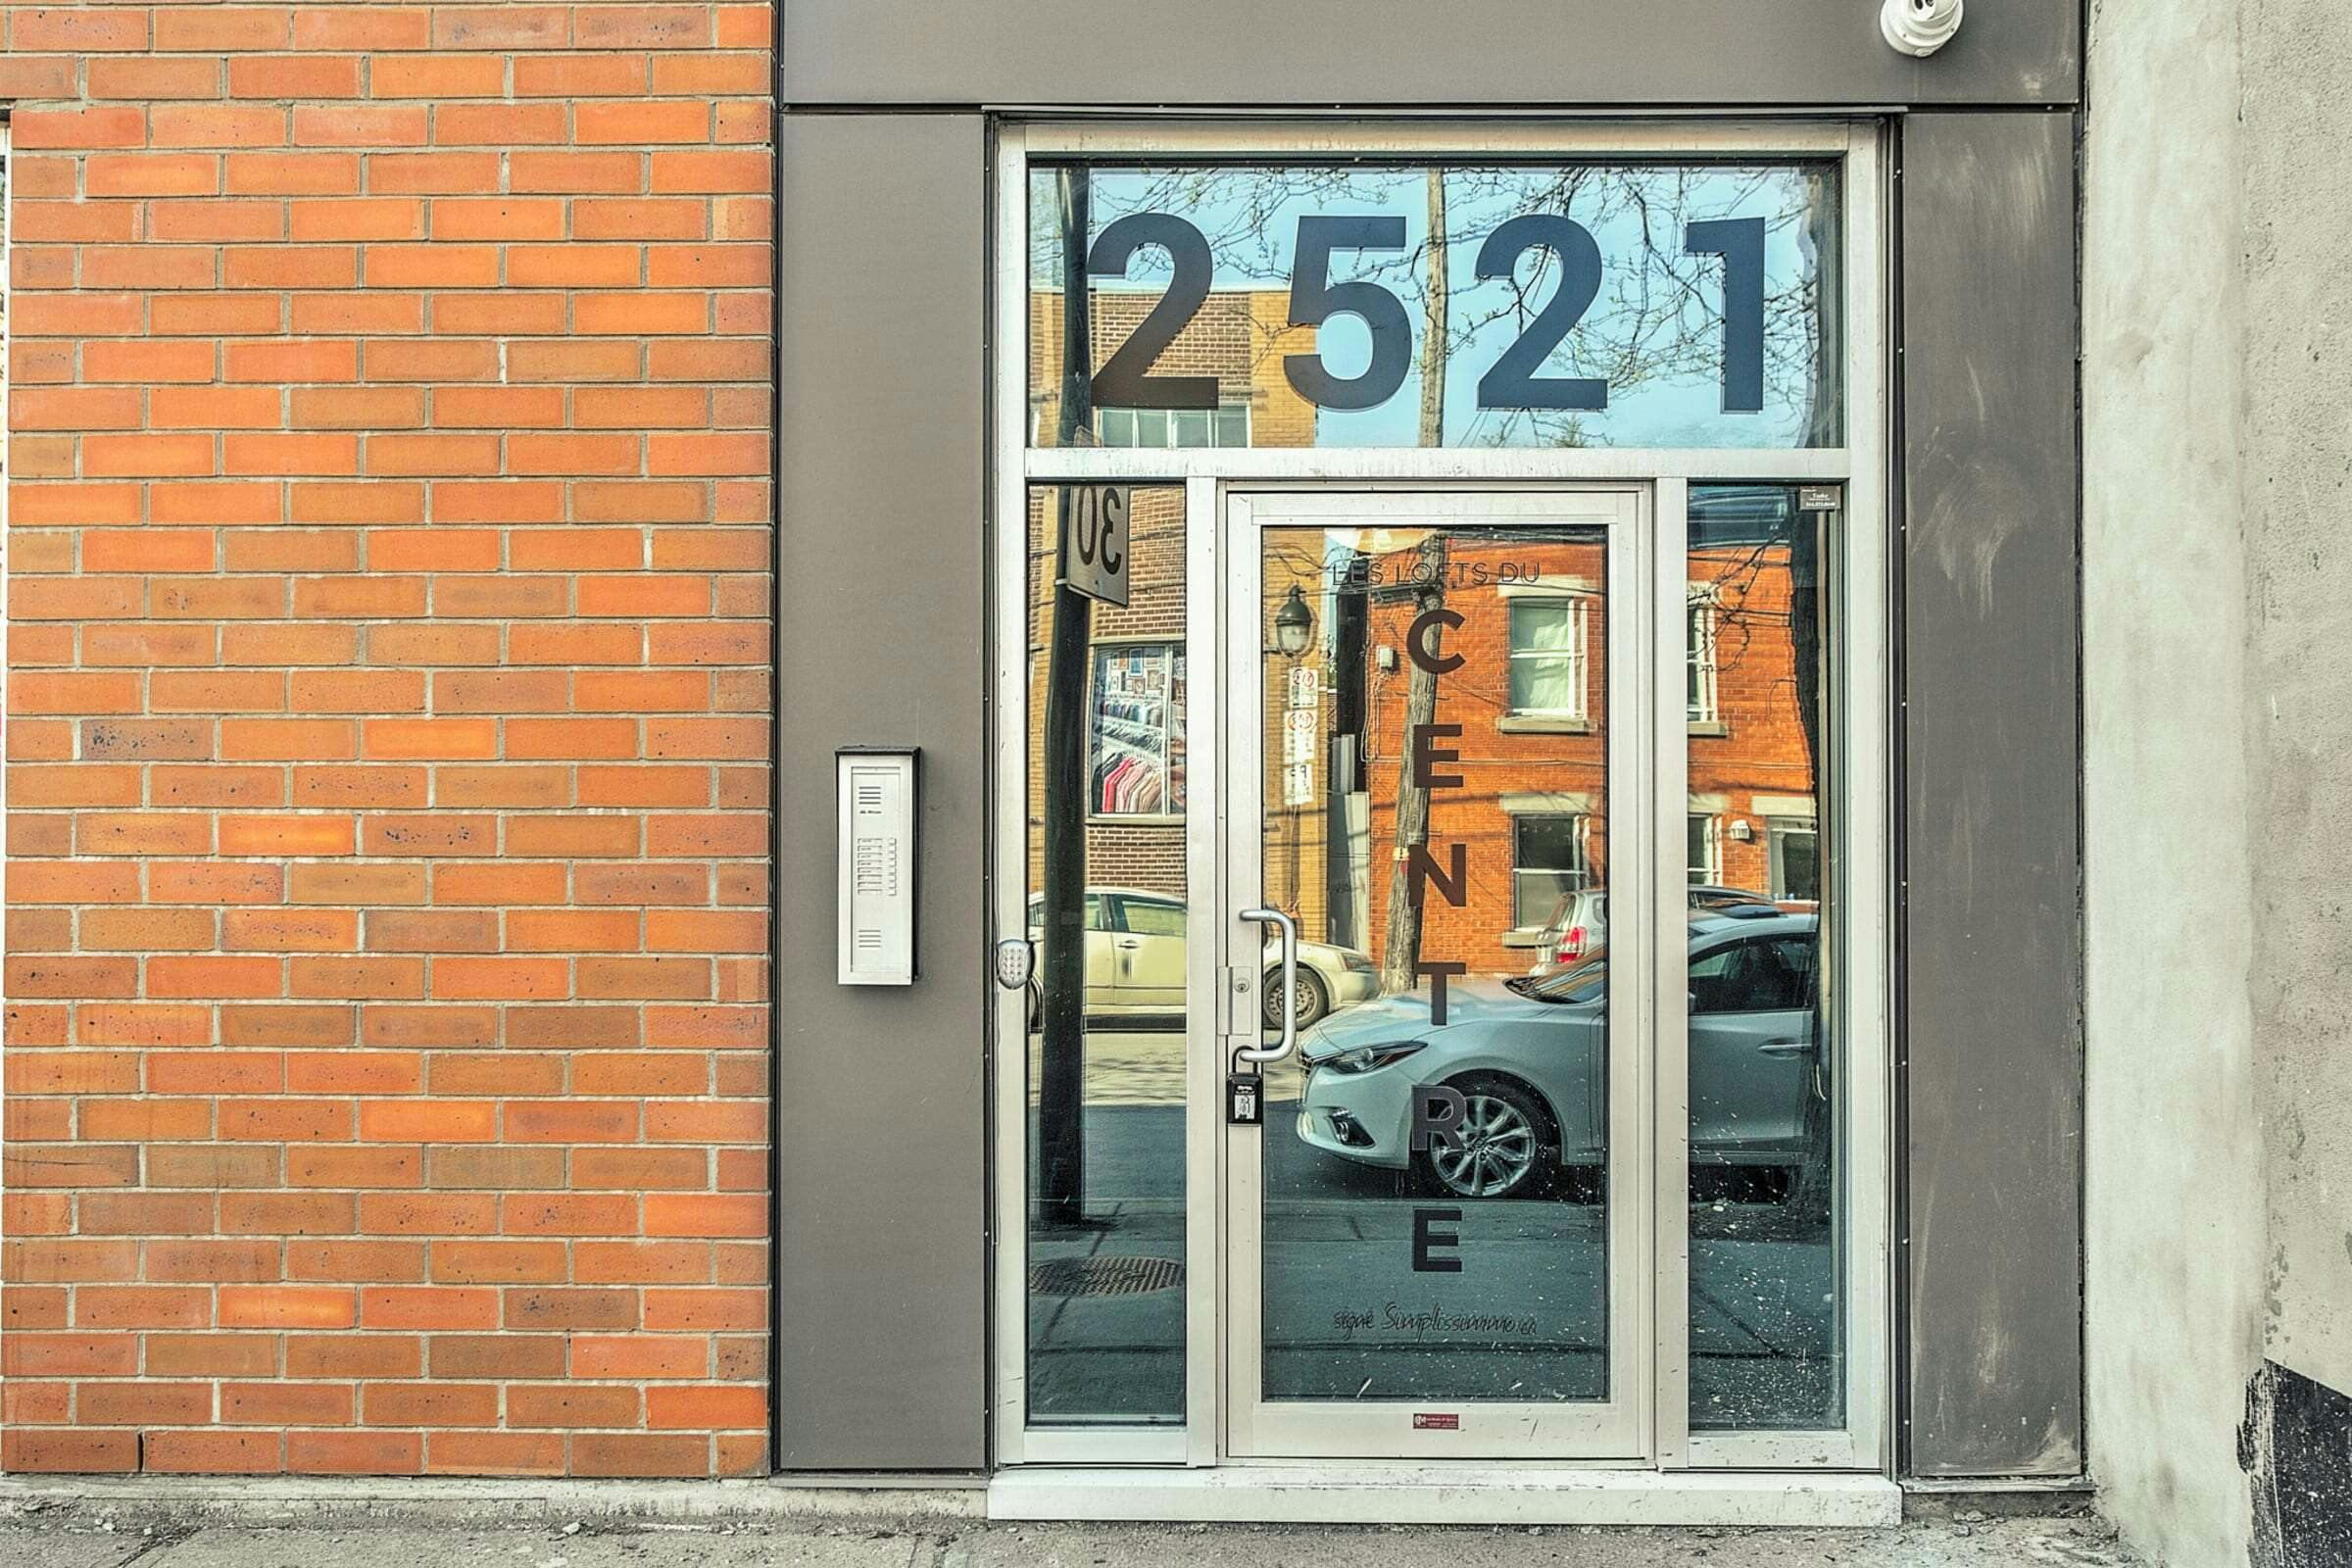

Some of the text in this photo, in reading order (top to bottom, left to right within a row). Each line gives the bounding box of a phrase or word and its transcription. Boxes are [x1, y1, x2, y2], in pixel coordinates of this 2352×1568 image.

[1088, 214, 1766, 411] 2521
[1332, 562, 1541, 585] LES LOFTS DU
[1407, 609, 1467, 1273] CENTRE
